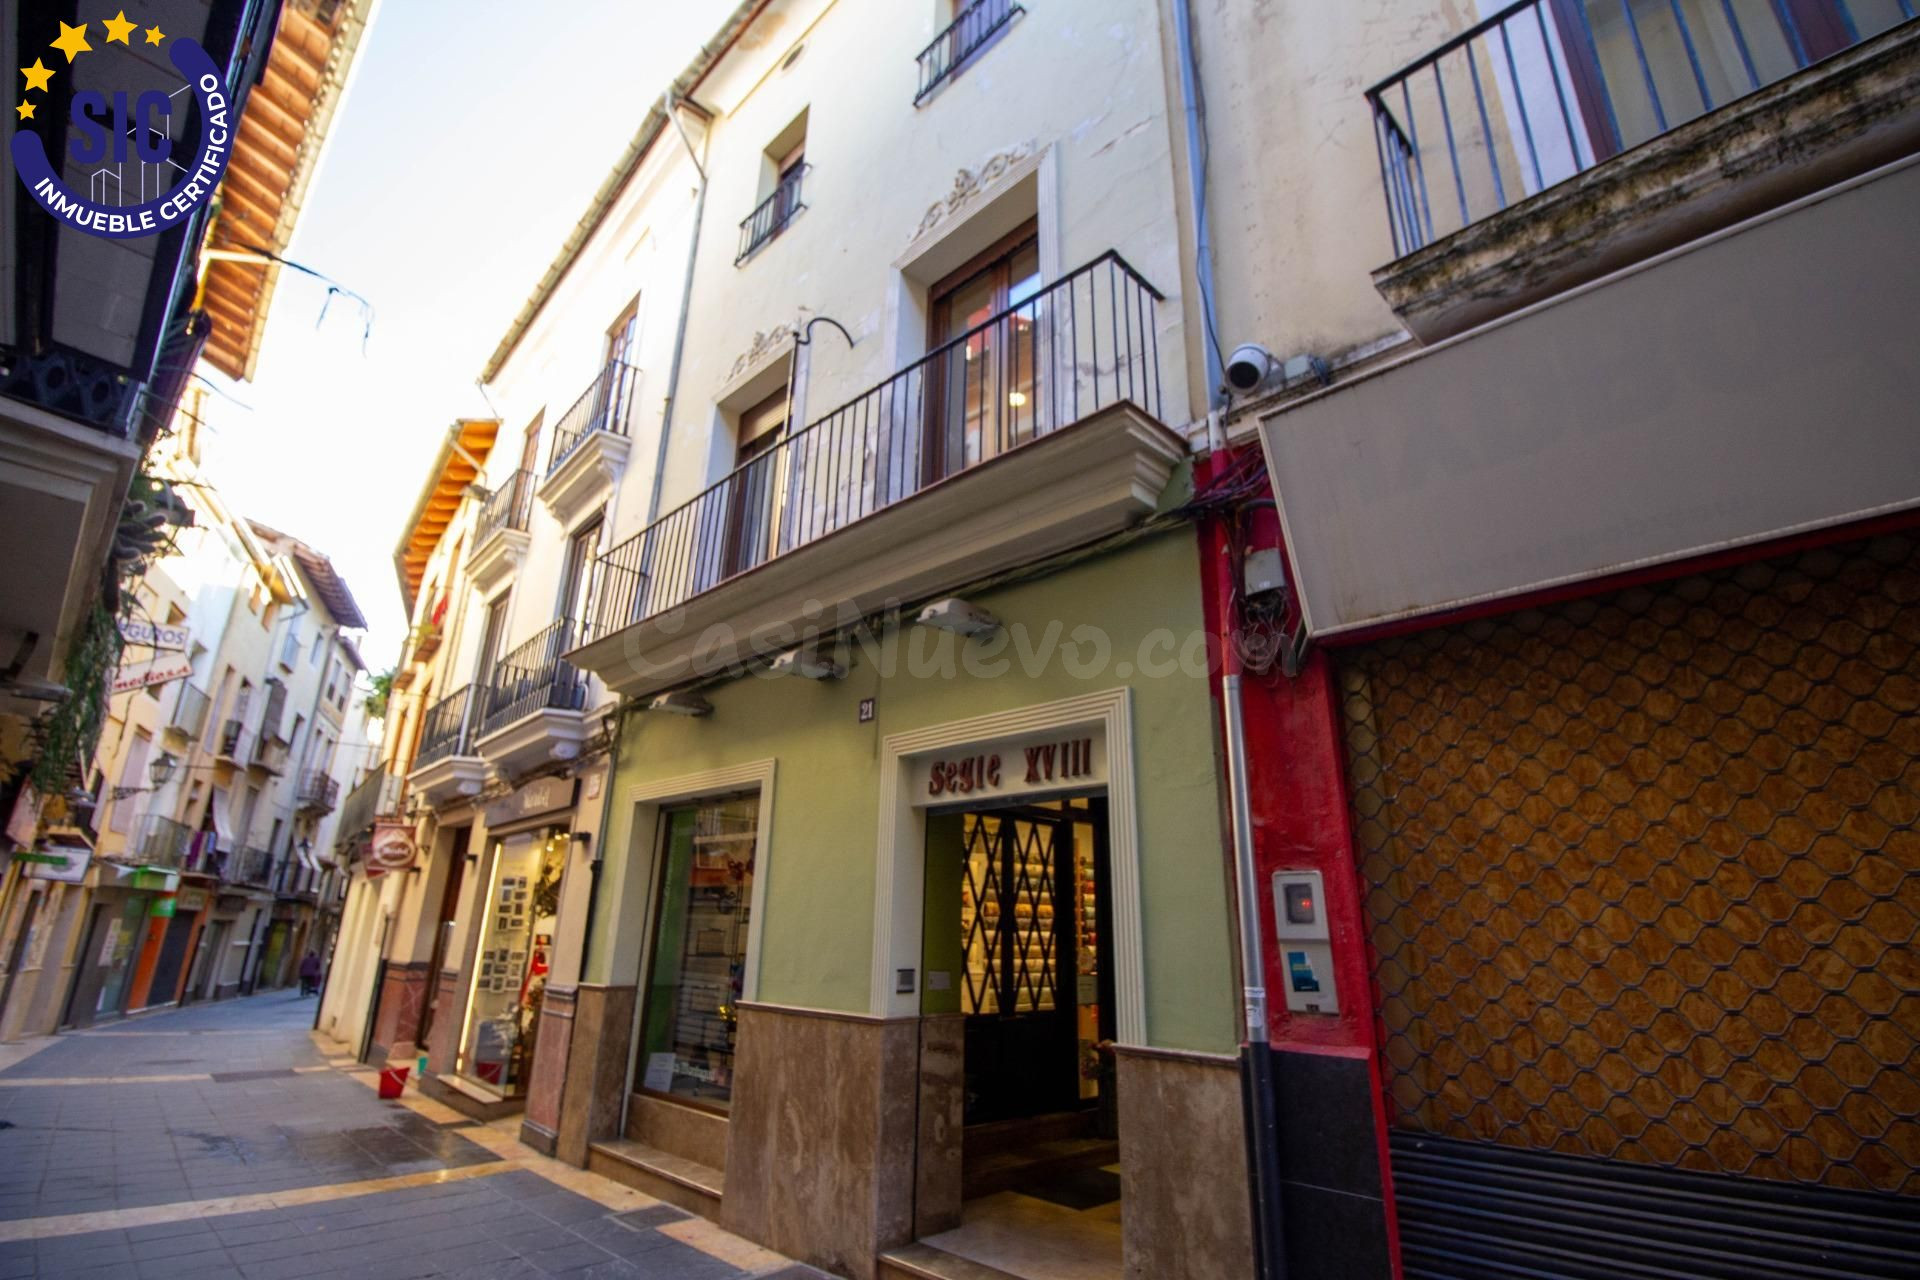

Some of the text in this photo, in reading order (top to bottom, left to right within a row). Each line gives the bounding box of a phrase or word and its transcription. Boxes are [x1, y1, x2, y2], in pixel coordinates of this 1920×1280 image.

[861, 701, 873, 720] 21
[928, 738, 1092, 795] Segle XVIII
